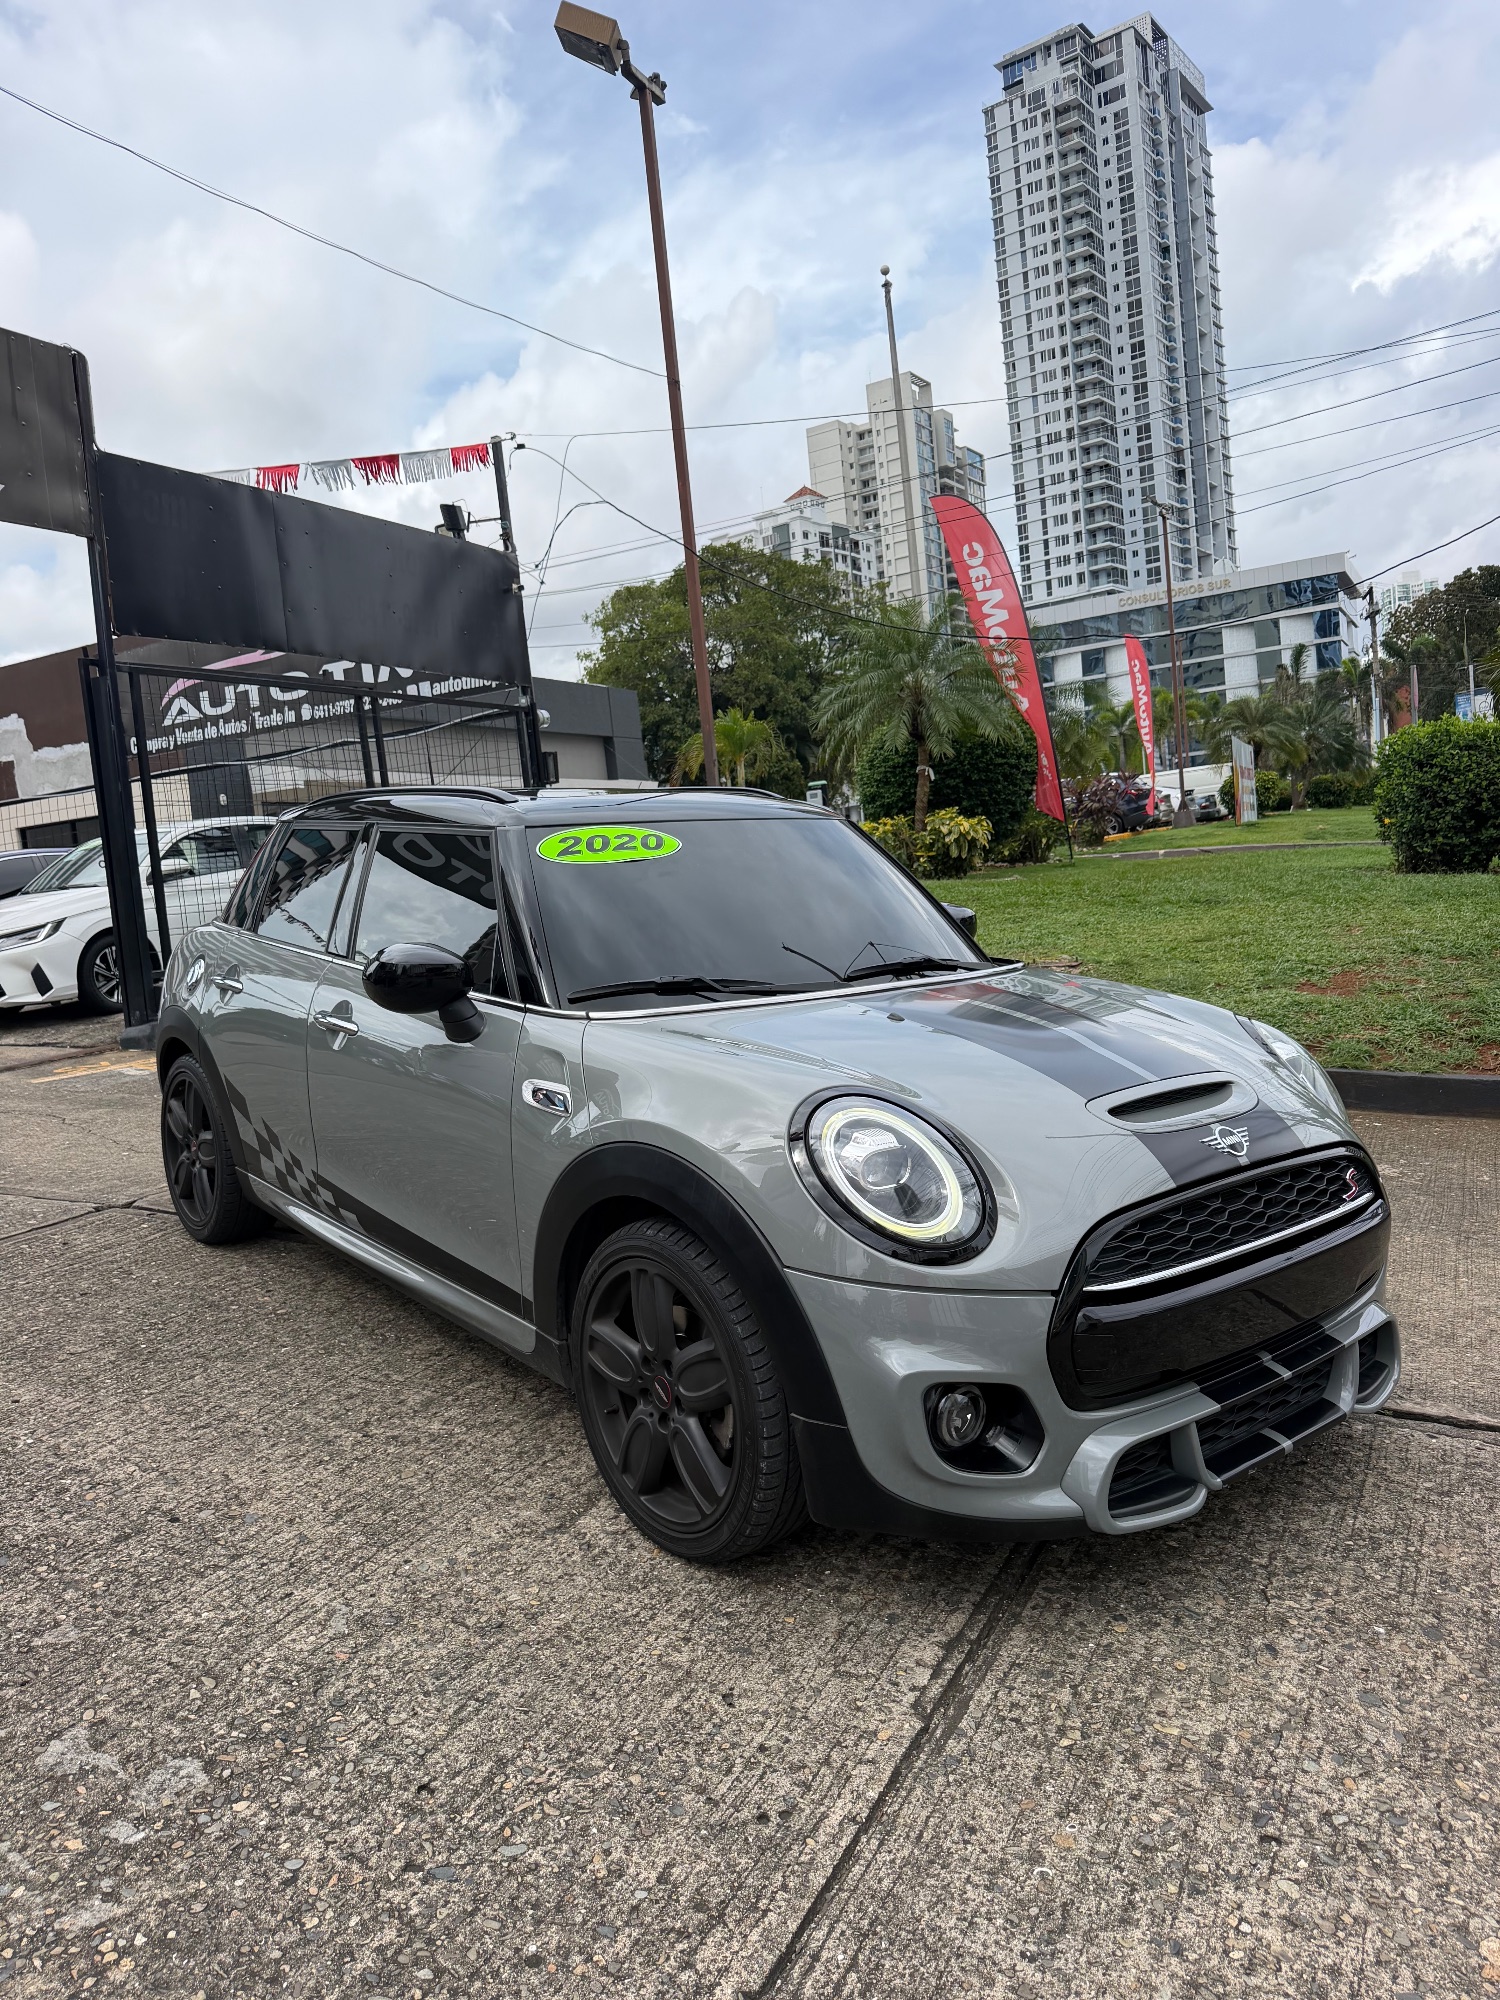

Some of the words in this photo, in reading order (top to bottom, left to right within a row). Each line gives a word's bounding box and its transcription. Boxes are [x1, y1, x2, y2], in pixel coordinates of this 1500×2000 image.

[1118, 583, 1204, 607] CONSULTORIOS
[1207, 578, 1231, 591] SUR
[205, 721, 218, 738] de
[218, 718, 247, 737] Autos
[252, 708, 283, 730] Trade
[556, 833, 666, 858] 2020
[1222, 1134, 1241, 1146] MINI
[1342, 1168, 1358, 1201] S
